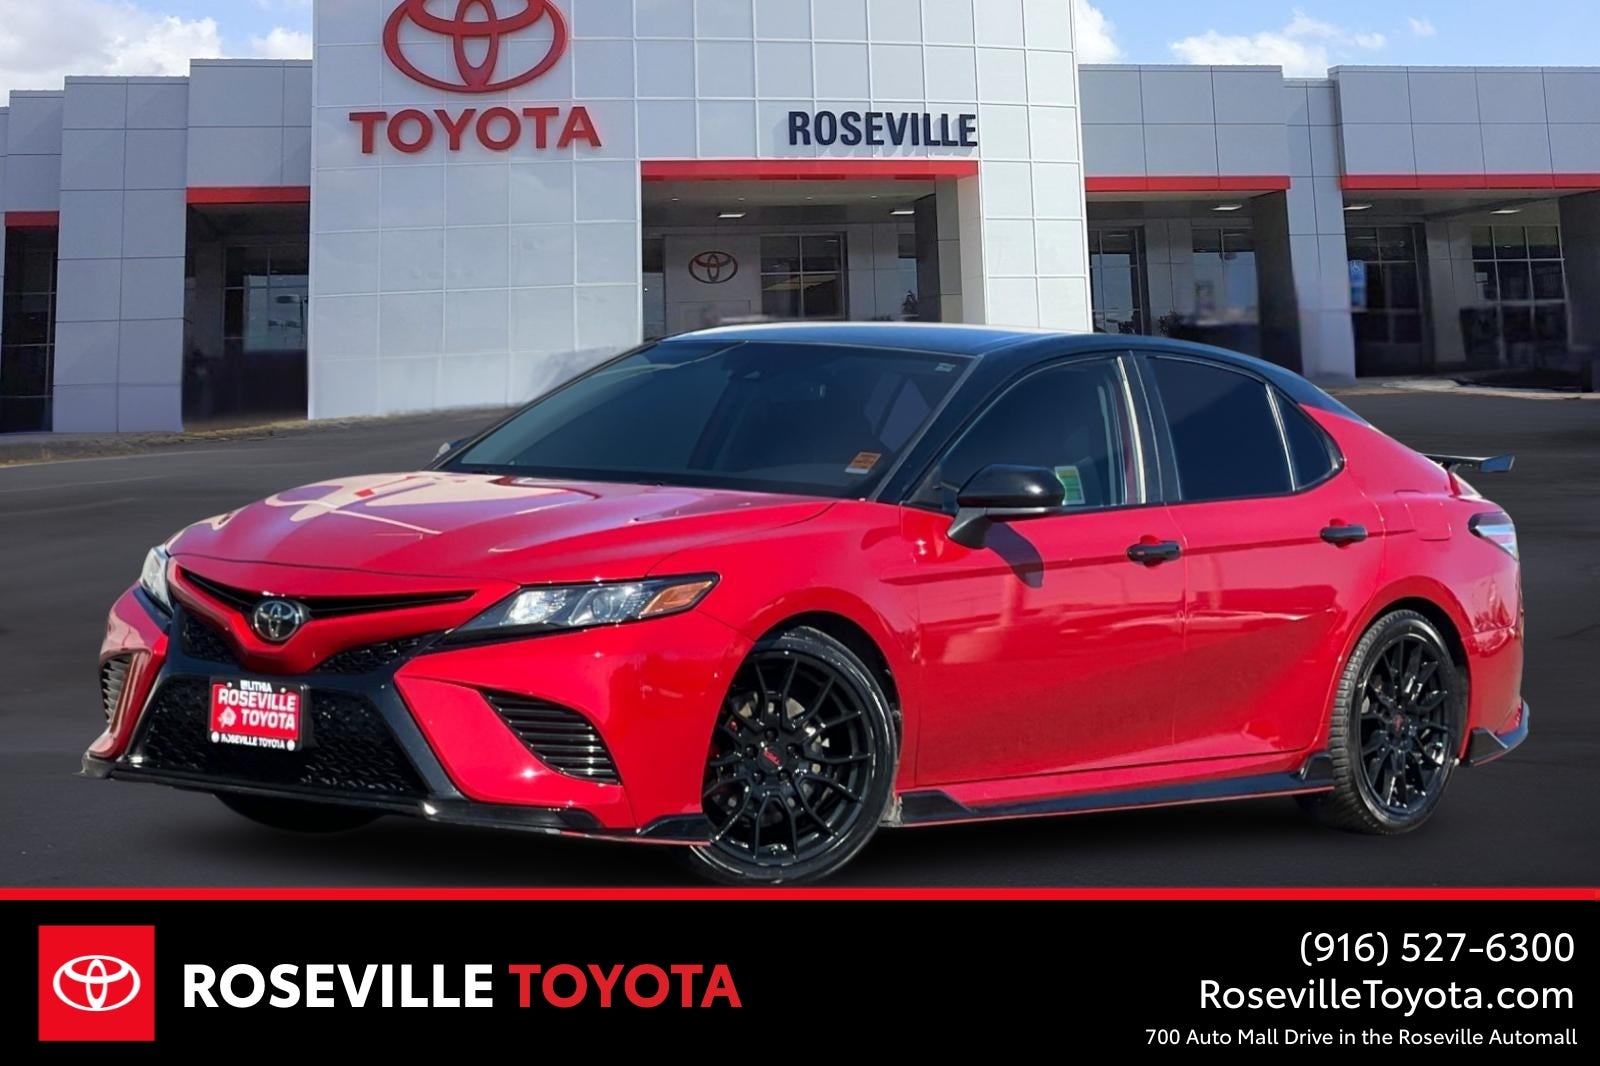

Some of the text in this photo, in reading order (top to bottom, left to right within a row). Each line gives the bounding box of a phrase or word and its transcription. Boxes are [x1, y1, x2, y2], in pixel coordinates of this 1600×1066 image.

[349, 106, 602, 153] TOYOTA
[788, 110, 979, 148] ROSEVILLE
[217, 688, 297, 712] ROSEVILLE
[240, 708, 296, 731] TOYOTA
[258, 737, 286, 750] TOYOTA
